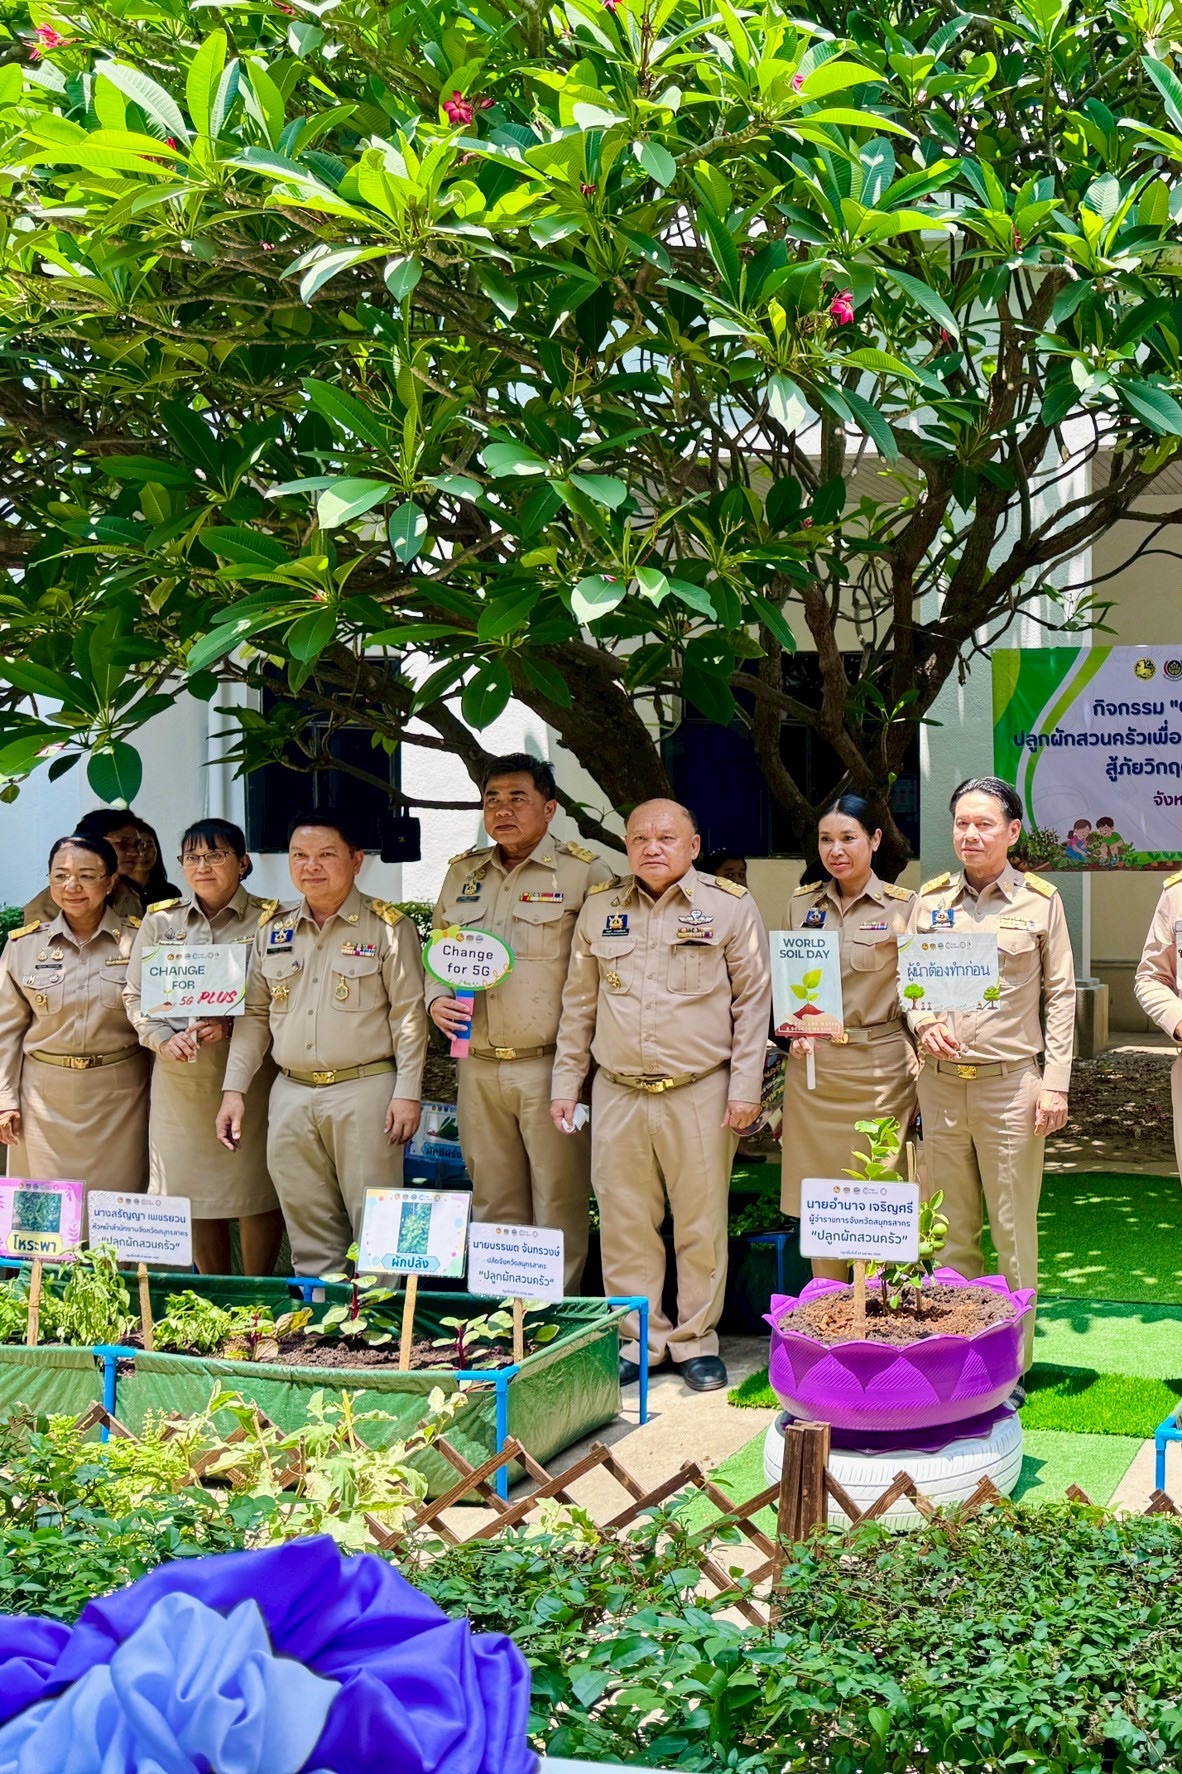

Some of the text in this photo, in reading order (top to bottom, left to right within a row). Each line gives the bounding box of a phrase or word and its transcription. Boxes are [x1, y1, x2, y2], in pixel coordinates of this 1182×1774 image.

[1093, 699, 1164, 716] กิจกรรม
[783, 938, 826, 948] WORLD
[442, 945, 494, 962] Change
[780, 949, 830, 959] SOIL DAY
[149, 965, 205, 977] CHANGE
[447, 962, 490, 977] for 5G
[907, 961, 991, 982] ผู้นำต้องทำก่อน
[172, 981, 195, 990] FOR
[179, 990, 238, 1006] 5G PLUS
[806, 1197, 913, 1215] นายอำนาจ เจริญศรี
[13, 1234, 57, 1253] โหระพา
[391, 1255, 429, 1269] ผักปลัง
